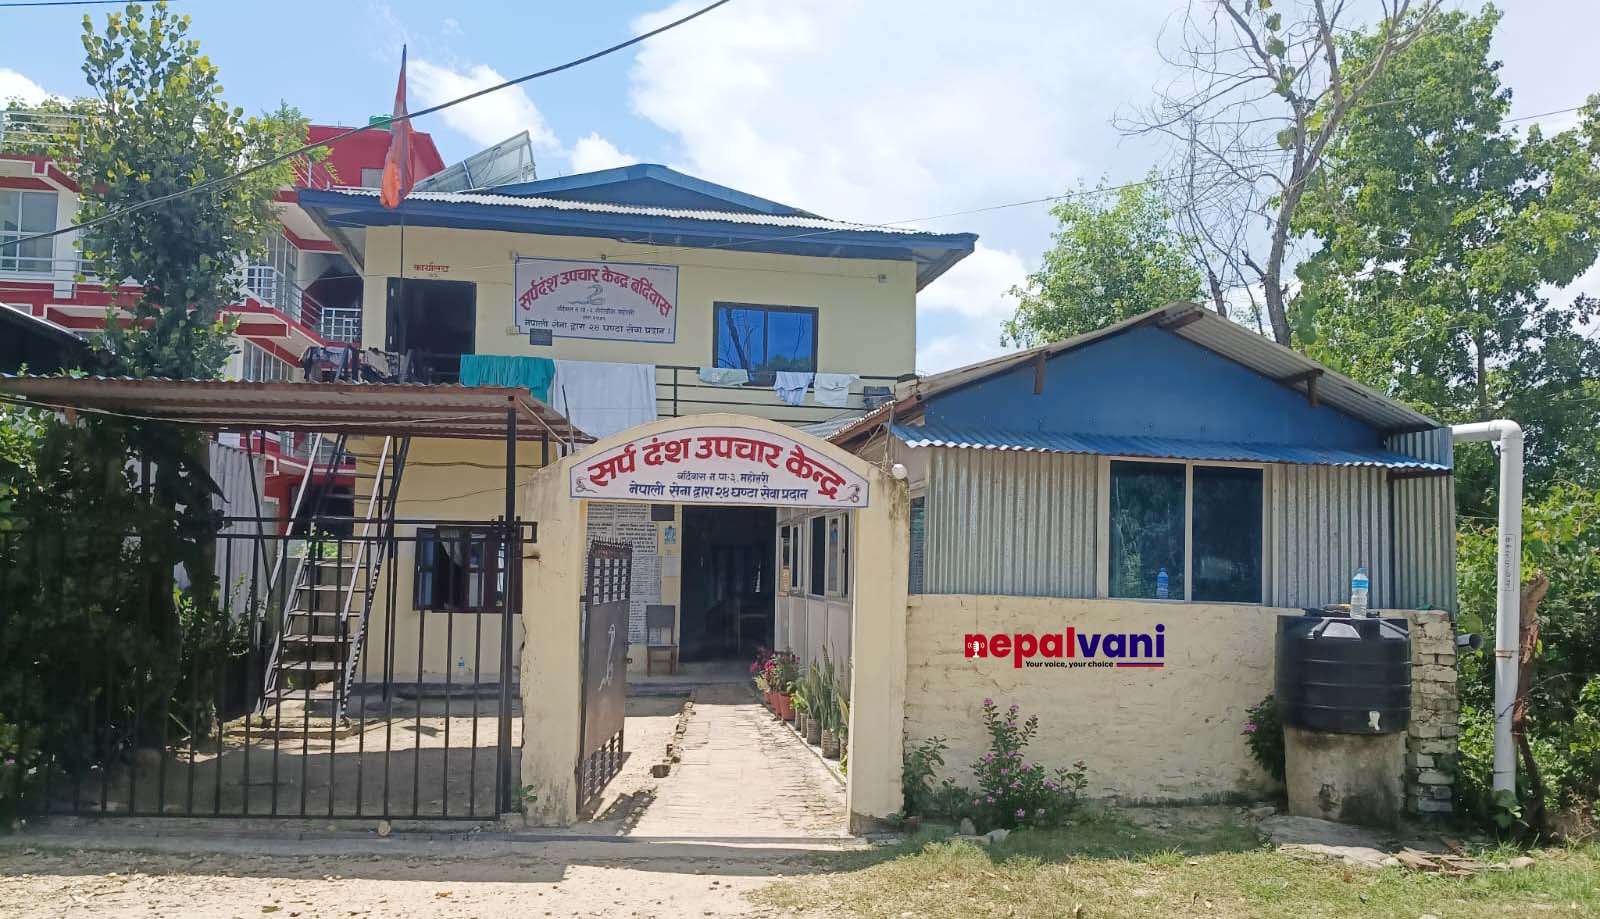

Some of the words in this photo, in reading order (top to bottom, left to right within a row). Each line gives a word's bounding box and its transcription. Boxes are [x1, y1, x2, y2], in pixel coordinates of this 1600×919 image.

[518, 274, 559, 312] सर्पदंश
[559, 268, 600, 285] उपचार
[601, 265, 631, 289] केन्द्र
[587, 443, 637, 487] सर्प
[642, 437, 692, 467] दंश
[695, 436, 783, 469] उपचार
[785, 444, 847, 500] केन्द्र
[628, 480, 665, 497] नेपाली
[669, 482, 691, 499] सेना
[692, 484, 714, 500] द्वारा
[714, 486, 730, 500] २४
[730, 487, 759, 500] घण्टा
[759, 485, 780, 501] सेवा
[781, 488, 808, 503] प्रदान
